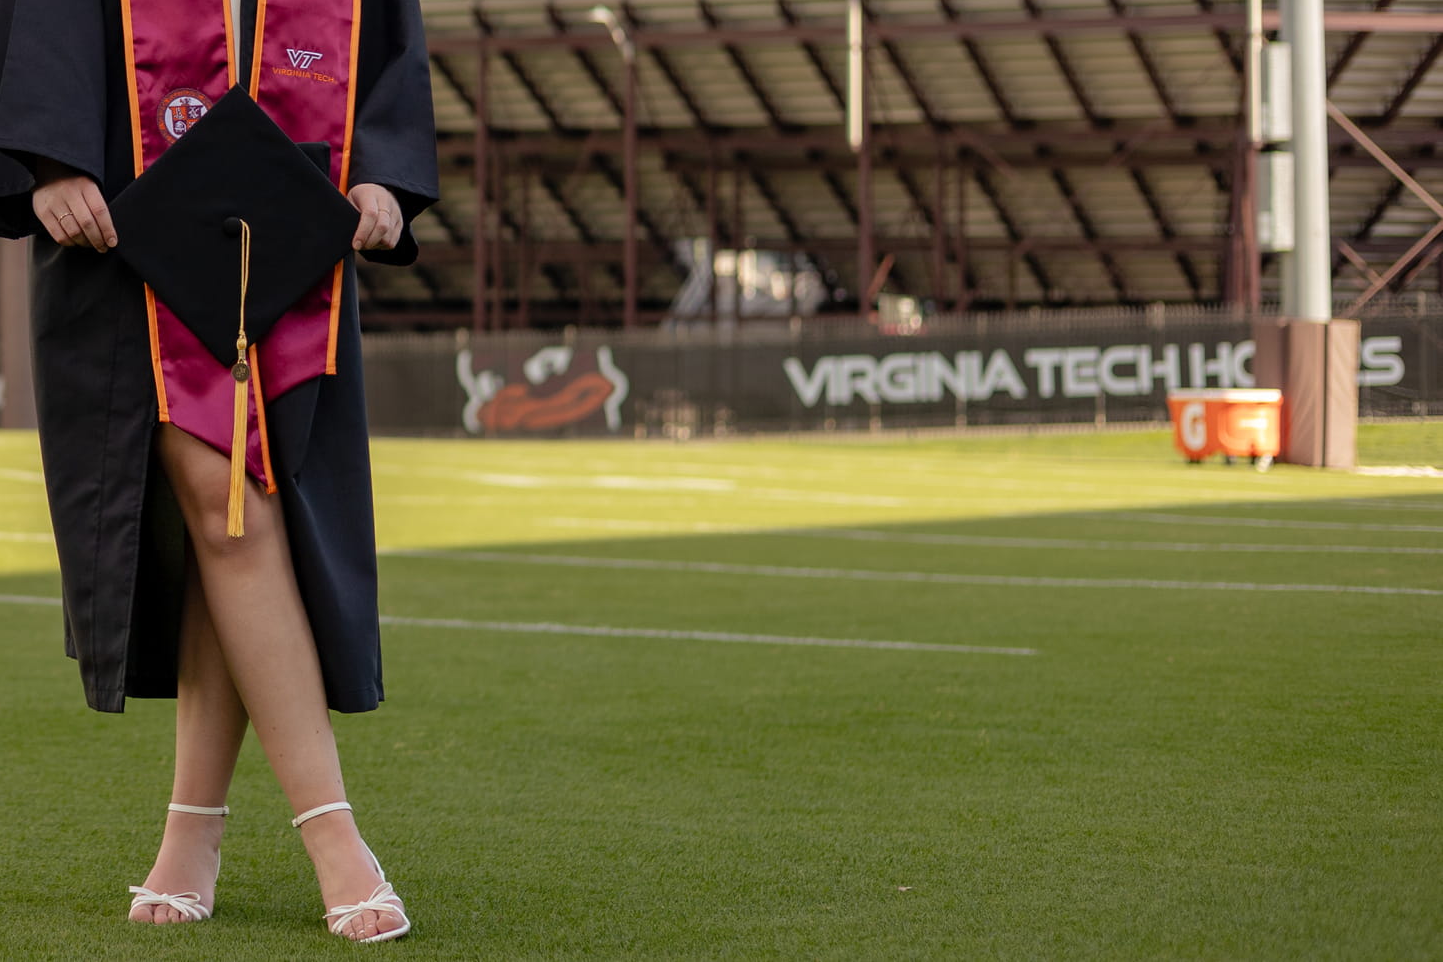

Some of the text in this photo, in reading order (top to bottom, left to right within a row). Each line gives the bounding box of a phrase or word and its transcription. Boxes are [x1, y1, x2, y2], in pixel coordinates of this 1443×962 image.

[271, 67, 311, 79] VIRGINIA
[286, 48, 323, 69] VT
[782, 348, 1028, 408] VIRGINIA
[1023, 343, 1181, 399] TECH
[1180, 402, 1207, 452] G
